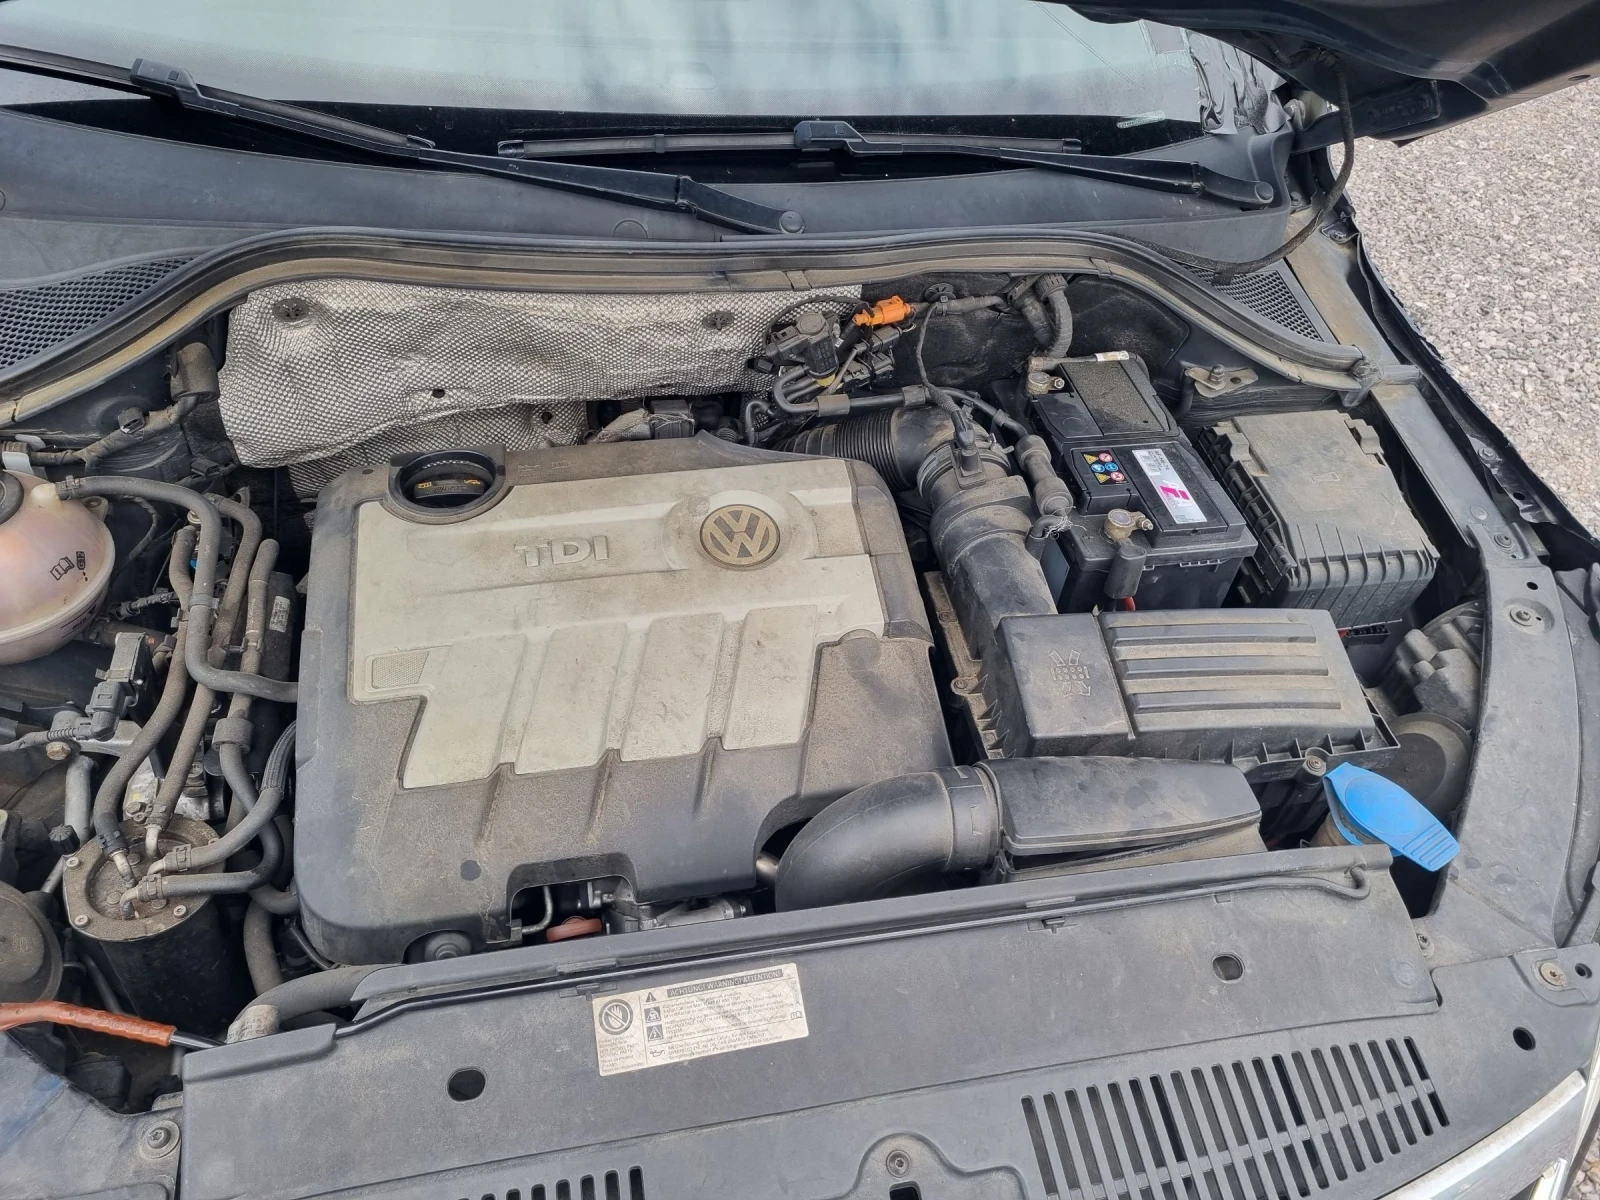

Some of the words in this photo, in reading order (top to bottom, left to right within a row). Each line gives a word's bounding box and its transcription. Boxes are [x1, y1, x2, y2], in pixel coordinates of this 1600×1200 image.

[700, 504, 780, 567] VW
[76, 551, 85, 570] G12
[514, 535, 610, 567] TDI
[669, 983, 706, 996] ACHTUNG!
[707, 977, 742, 989] WARNING!
[743, 970, 781, 983] ATTENTION!
